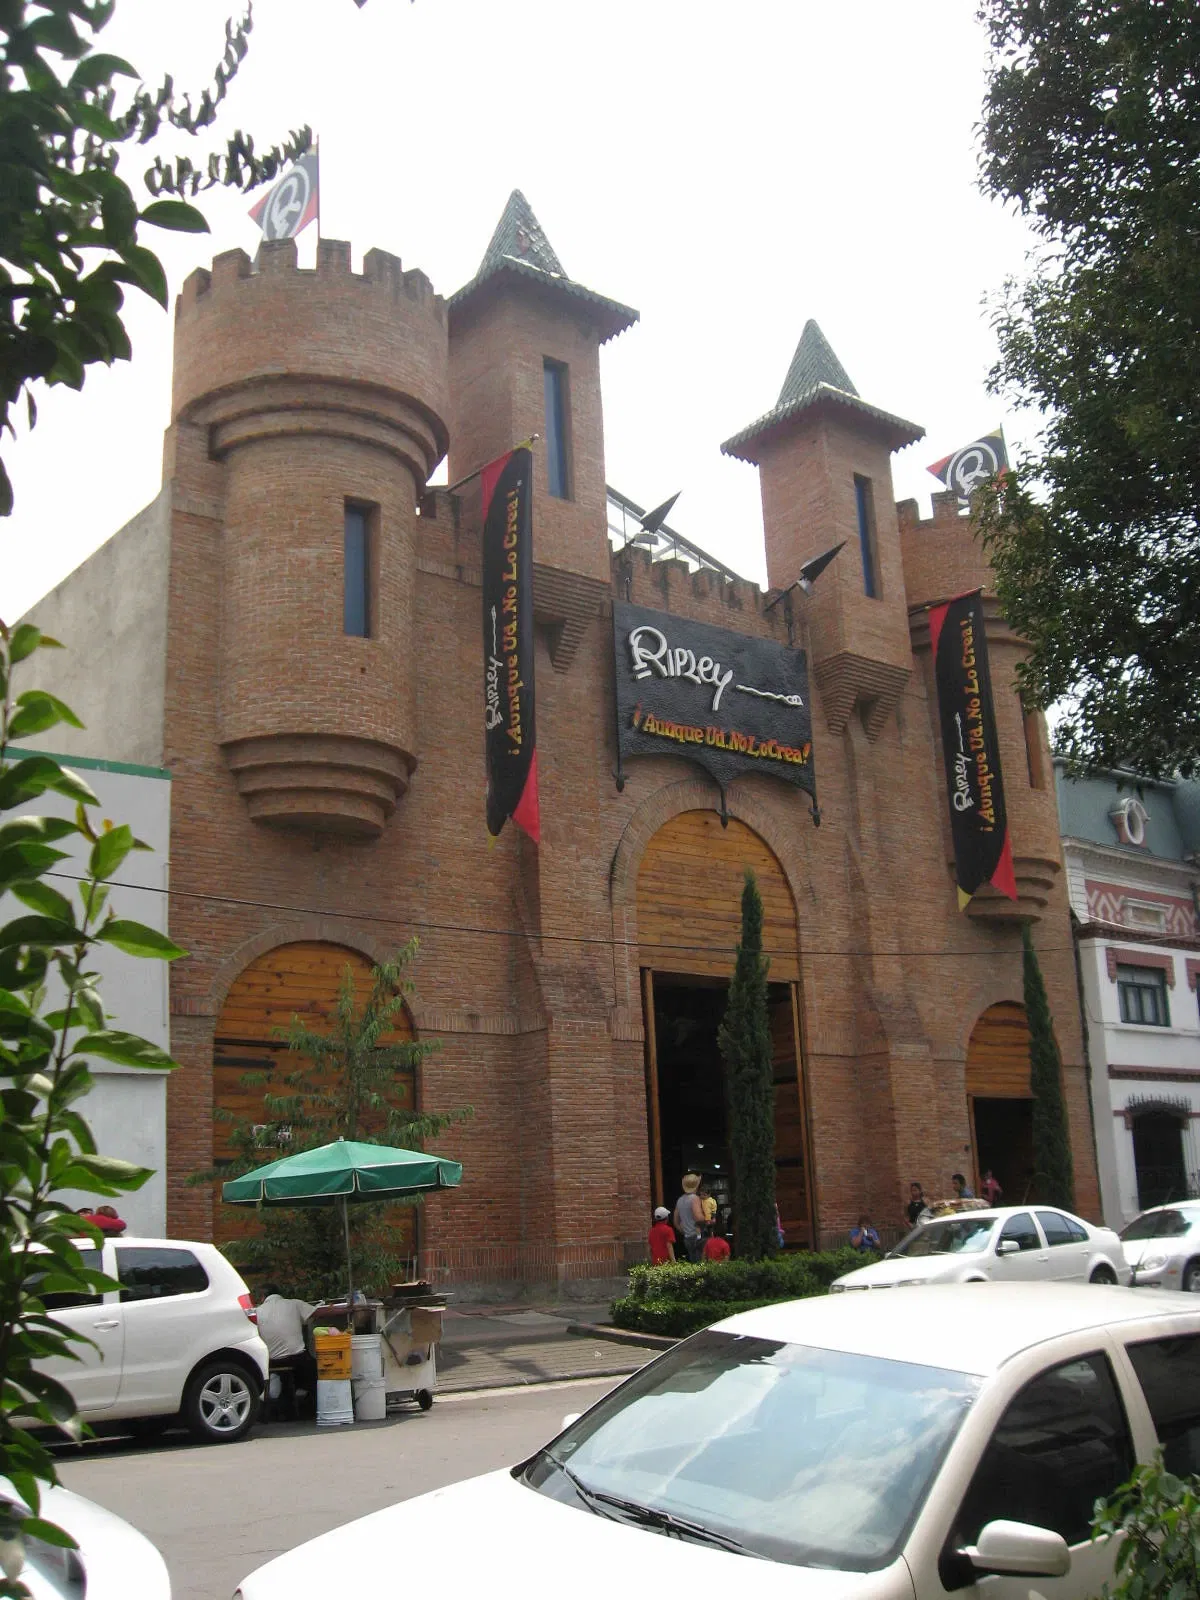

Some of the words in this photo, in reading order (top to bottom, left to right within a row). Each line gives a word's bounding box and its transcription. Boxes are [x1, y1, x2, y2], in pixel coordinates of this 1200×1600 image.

[502, 551, 518, 581] Lo
[503, 586, 518, 613] No
[964, 669, 979, 695] Lo
[966, 697, 982, 722] No
[728, 730, 746, 752] No
[744, 735, 768, 758] Lo
[765, 738, 812, 766] Crea!
